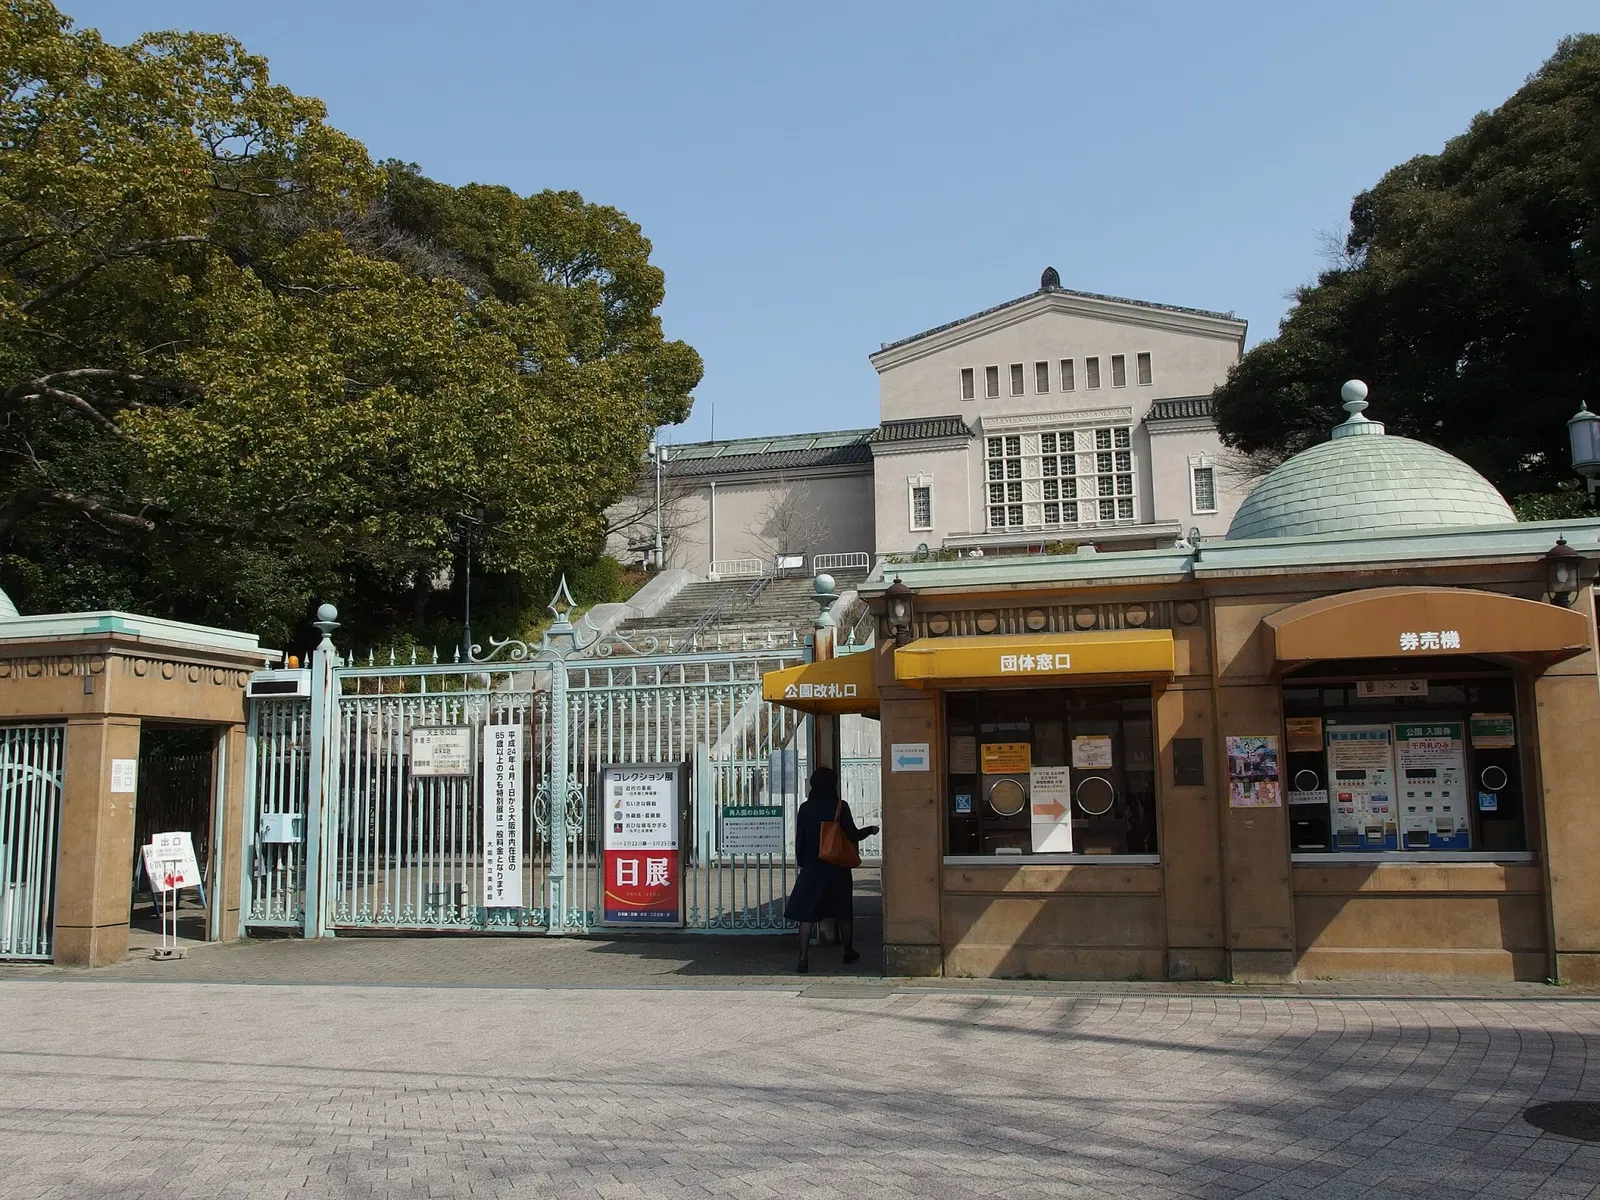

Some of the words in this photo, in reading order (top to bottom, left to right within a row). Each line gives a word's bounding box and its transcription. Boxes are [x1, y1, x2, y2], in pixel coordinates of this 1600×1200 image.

[1400, 631, 1460, 650] 券売機
[1001, 653, 1070, 672] 団体窓口
[785, 683, 857, 698] 公園改札口
[1405, 727, 1422, 736] 公園
[613, 772, 674, 781] コレクション展
[507, 731, 516, 871] 平成24年4月1日から大阪市内在住の
[495, 732, 504, 900] 65歳以上の方も特別展は一般料金となります。
[161, 837, 181, 846] 出口
[616, 857, 671, 887] 日展
